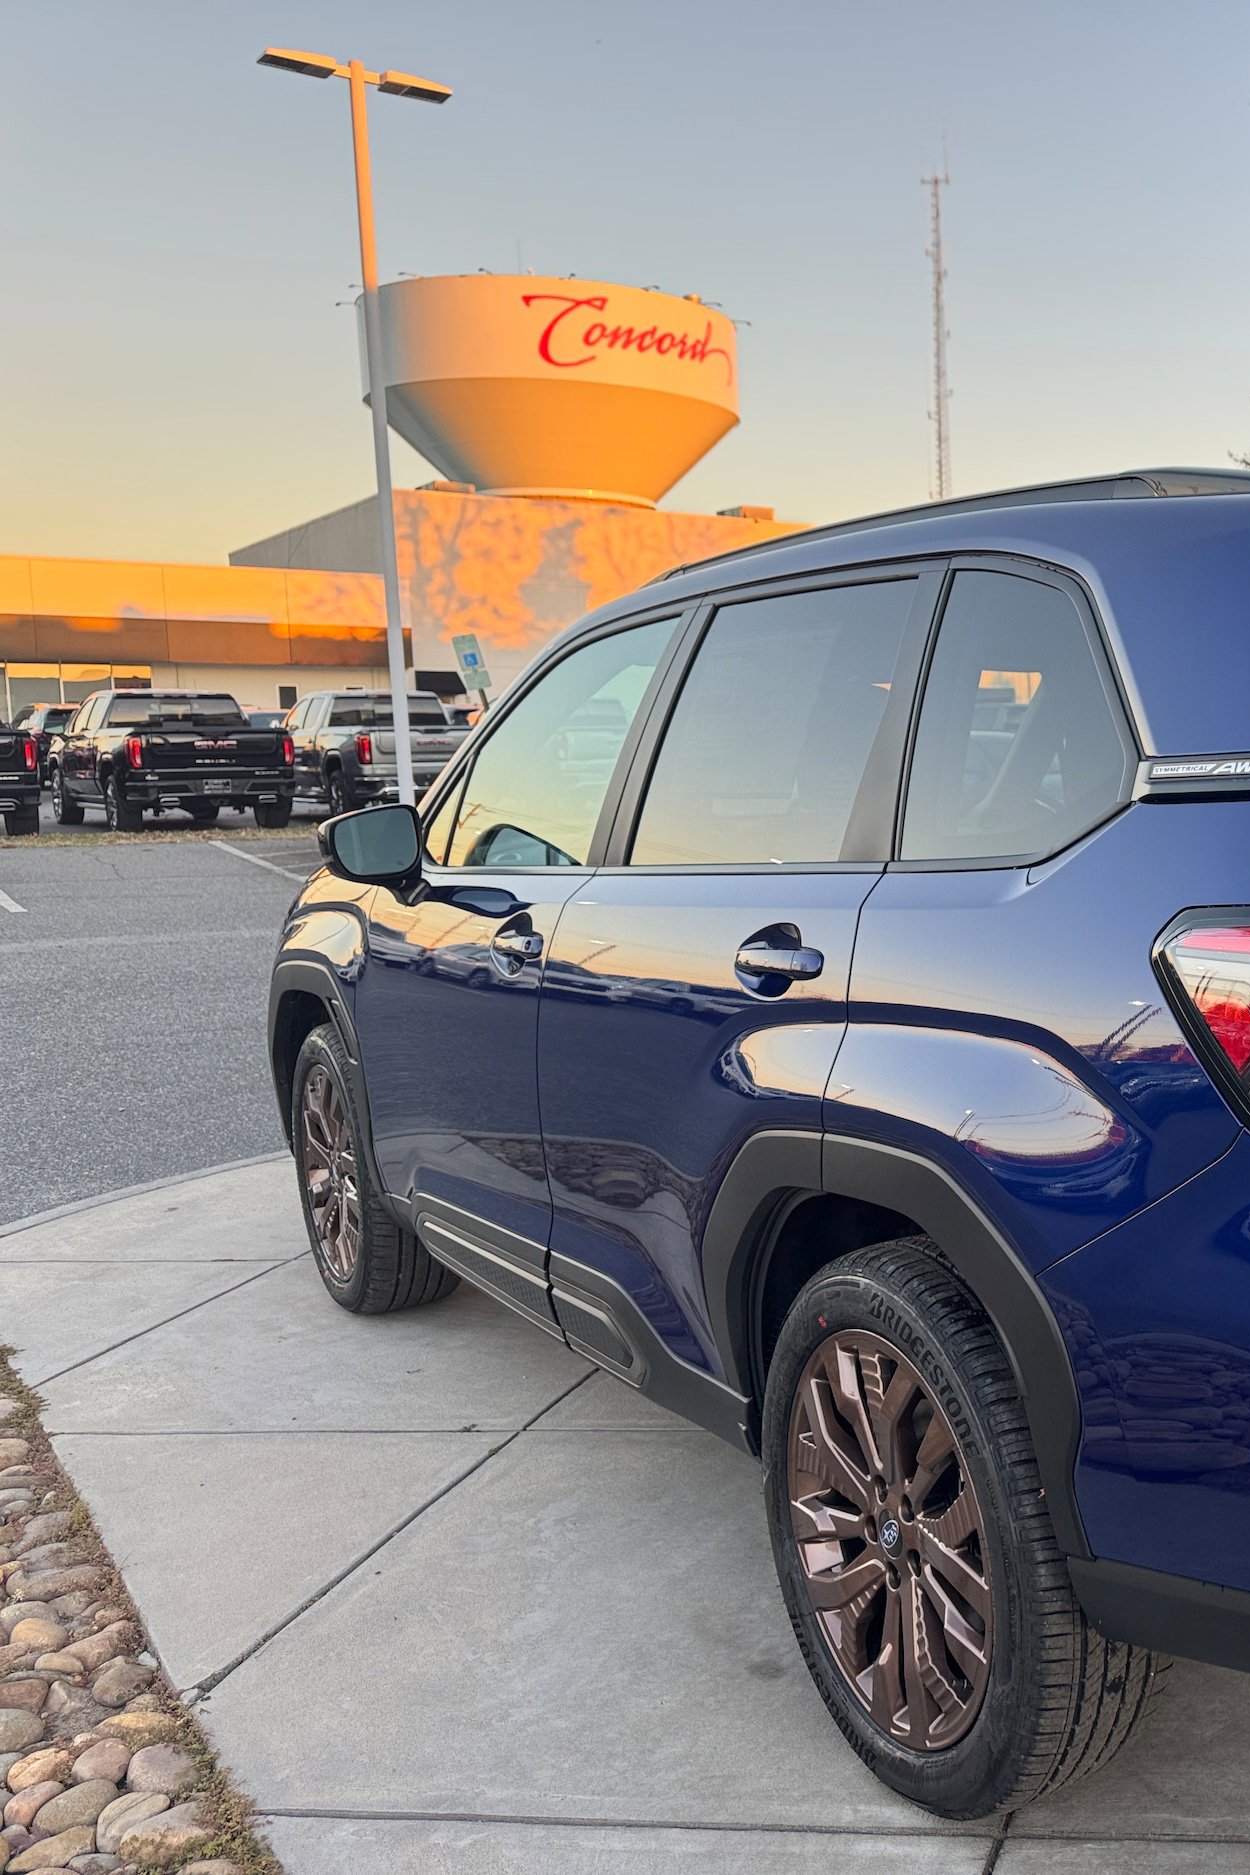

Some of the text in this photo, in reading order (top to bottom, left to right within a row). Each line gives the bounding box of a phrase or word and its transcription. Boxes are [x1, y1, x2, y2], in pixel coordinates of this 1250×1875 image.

[521, 294, 733, 387] Concord
[1154, 764, 1209, 774] SYMMETRICAL
[867, 1292, 981, 1459] BRIDGESTONE
